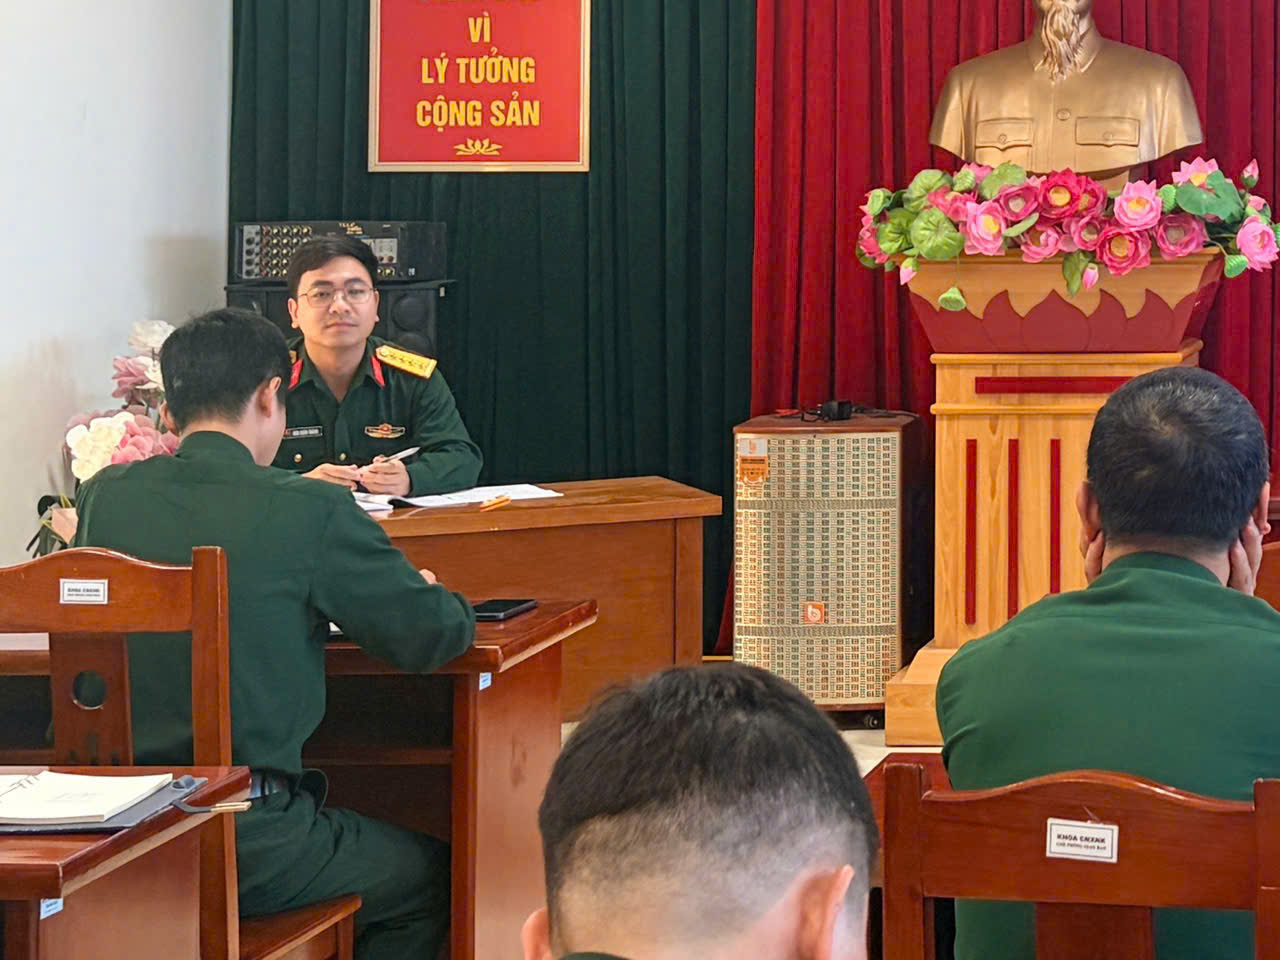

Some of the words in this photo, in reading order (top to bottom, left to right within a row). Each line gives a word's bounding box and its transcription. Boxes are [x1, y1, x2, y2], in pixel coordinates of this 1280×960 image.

[468, 11, 490, 43] VÌ
[421, 52, 449, 83] LÝ
[456, 47, 535, 83] TƯỞNG
[416, 95, 482, 132] CỘNG
[490, 91, 540, 127] SẢN
